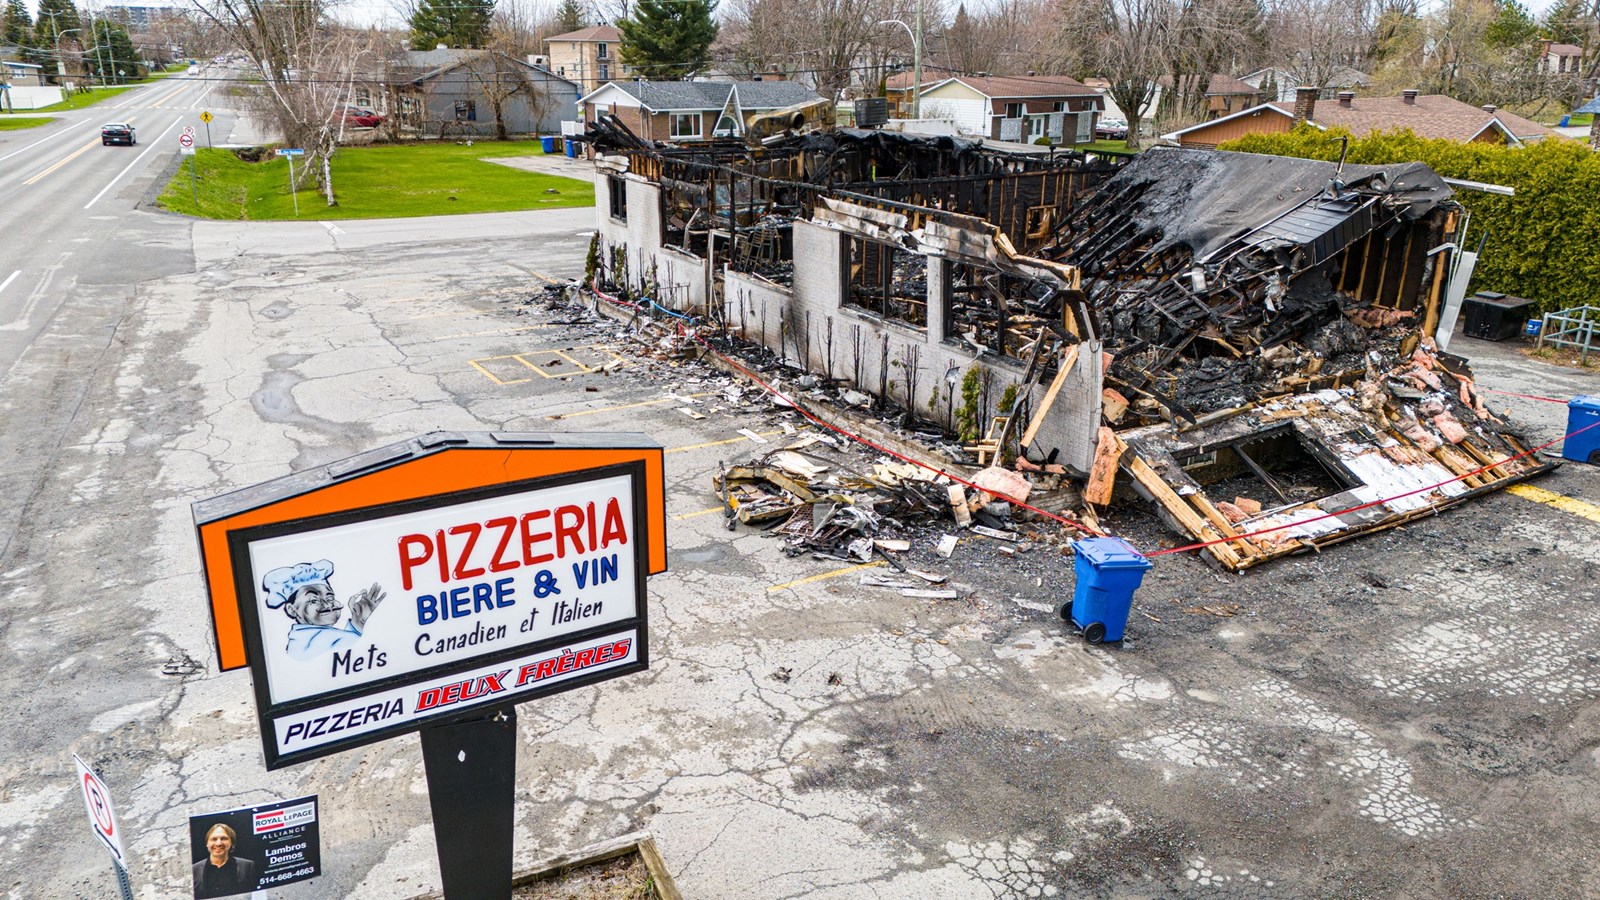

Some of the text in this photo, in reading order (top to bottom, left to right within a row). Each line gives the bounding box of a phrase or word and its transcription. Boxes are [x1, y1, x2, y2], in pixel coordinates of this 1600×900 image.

[397, 496, 628, 591] PIZZERIA
[416, 553, 618, 626] BIERE & VIN
[331, 597, 603, 678] Mets Canadien et Italien
[283, 637, 632, 745] PIZZERIA DEUX FRÈRES
[255, 817, 283, 827] ROYAL
[262, 826, 306, 839] ALLIANCE
[265, 842, 306, 857] Lambros
[269, 851, 303, 865] Demos
[259, 866, 314, 884] 514-668-4663
